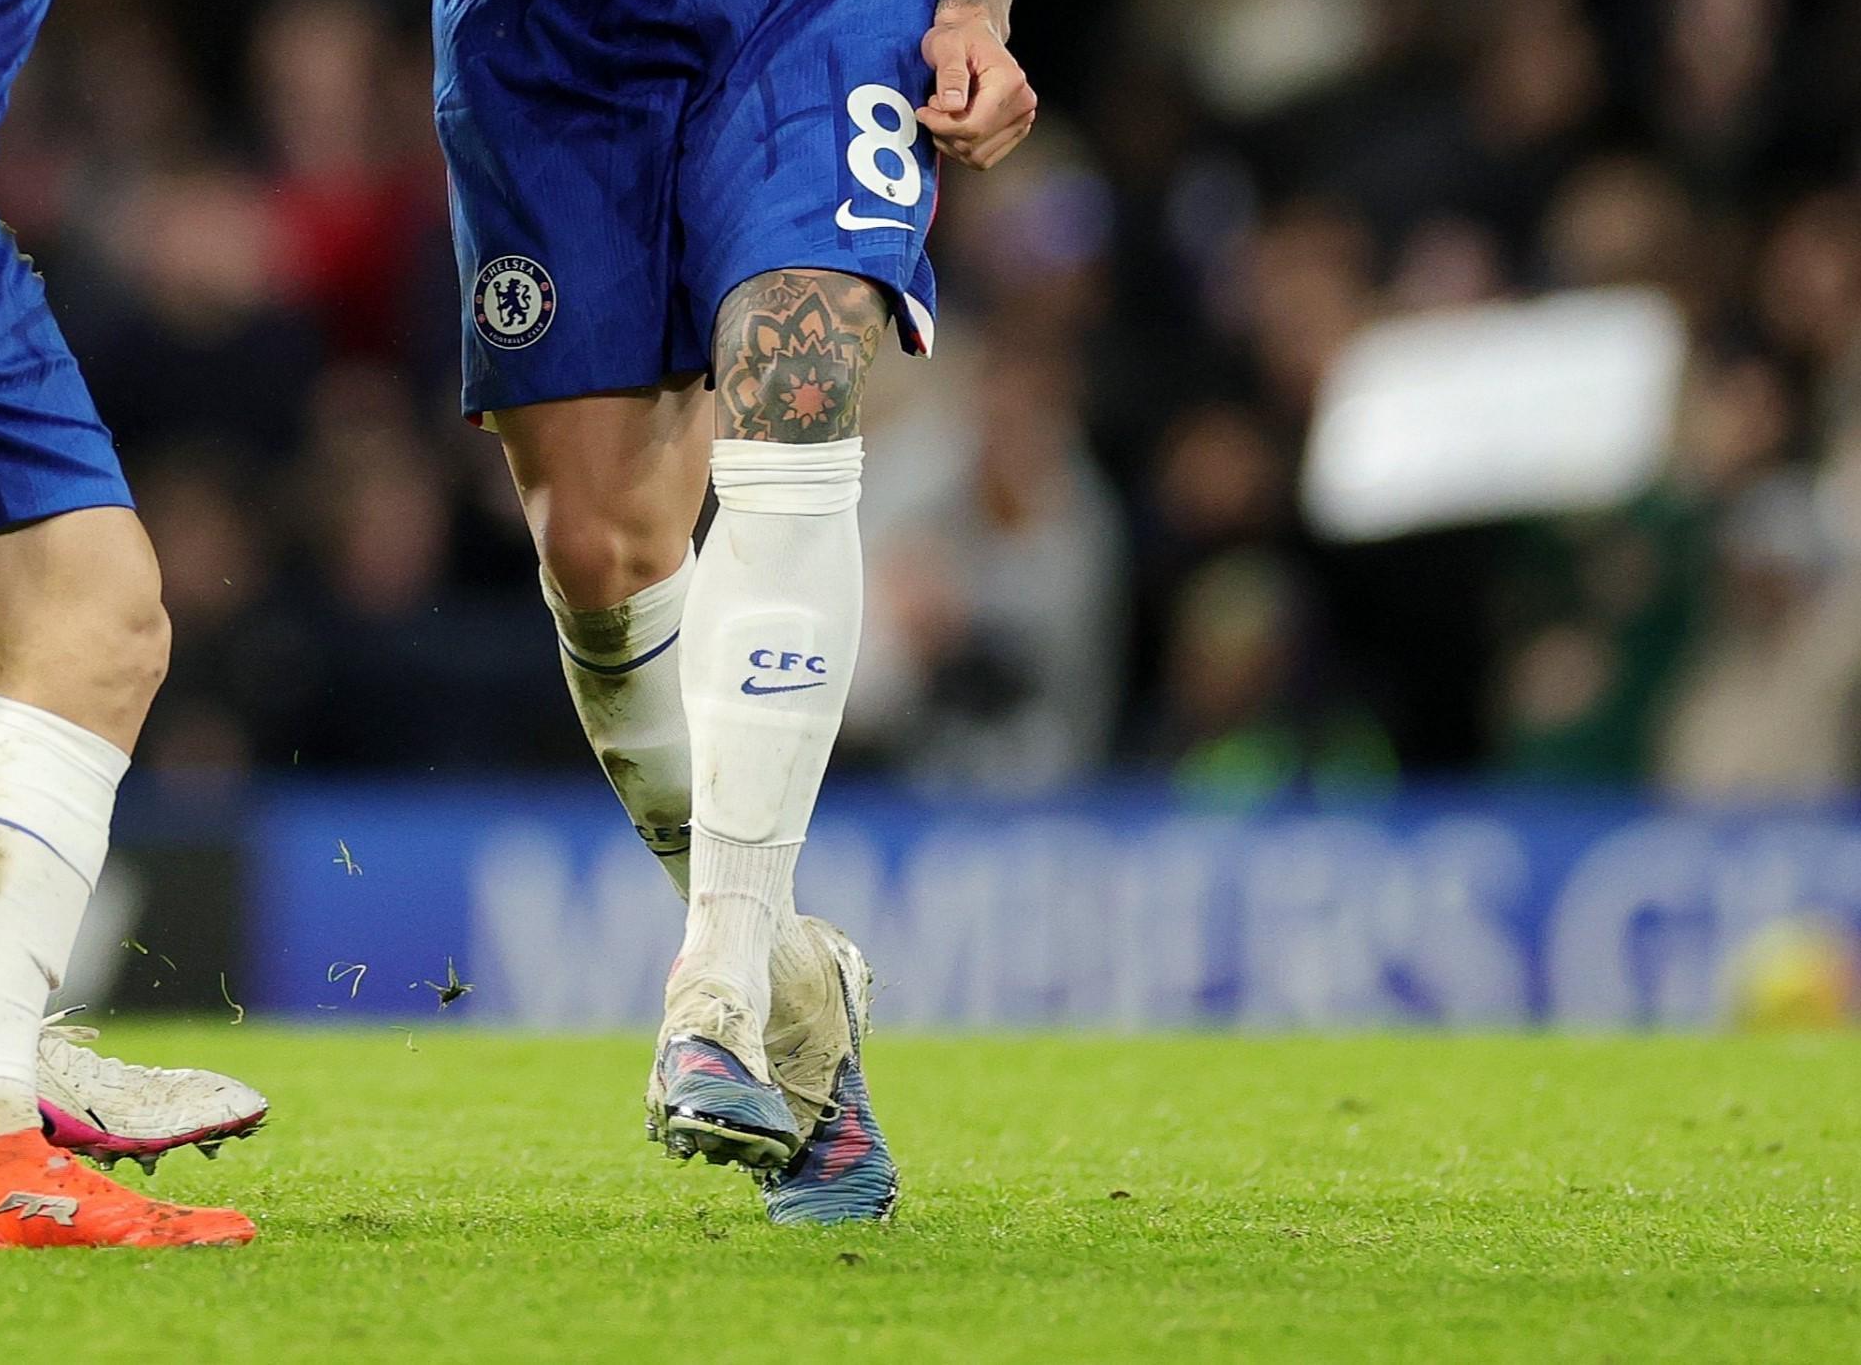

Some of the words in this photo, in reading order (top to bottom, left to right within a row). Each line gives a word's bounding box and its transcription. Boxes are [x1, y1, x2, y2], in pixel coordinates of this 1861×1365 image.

[846, 83, 922, 207] 8
[482, 259, 535, 283] CHELSEA
[748, 649, 827, 674] CFC
